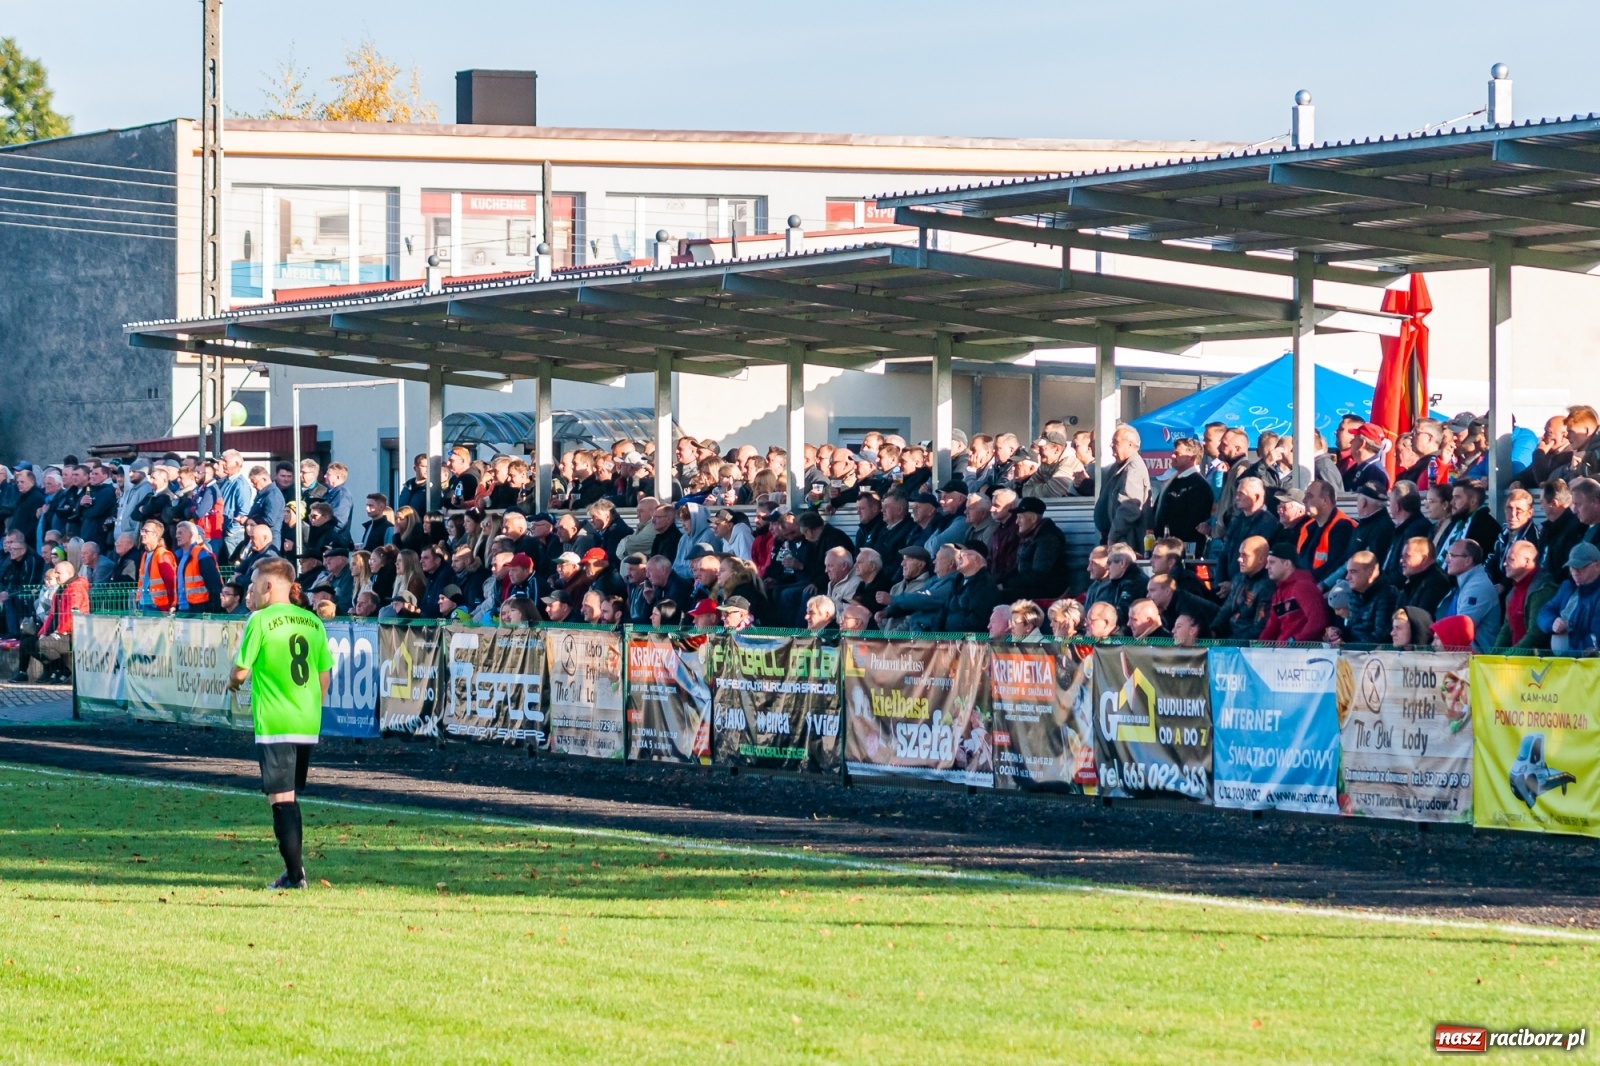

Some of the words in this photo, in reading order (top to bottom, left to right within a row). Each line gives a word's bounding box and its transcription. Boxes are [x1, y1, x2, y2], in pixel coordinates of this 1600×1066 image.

[470, 197, 527, 211] KUCHENNE
[281, 267, 321, 279] MEBLE
[325, 267, 341, 280] NA
[76, 650, 121, 675] PIŁKARSA
[289, 632, 309, 687] 8
[991, 659, 1053, 684] KREWETKA
[1215, 673, 1247, 692] SZYBKI
[1277, 668, 1326, 682] MARTCOM
[1402, 666, 1436, 689] Kebab
[1157, 698, 1206, 717] BUDUJEMY
[1402, 695, 1436, 724] Frytki
[725, 708, 746, 730] JAKO
[1220, 708, 1283, 732] INTERNET
[1494, 709, 1524, 727] POMOC
[1527, 711, 1572, 729] DROGOWA
[1573, 713, 1588, 730] 24h
[896, 709, 954, 761] szefa
[1159, 727, 1172, 744] OD
[1174, 729, 1182, 745] A
[1184, 730, 1198, 746] DO
[1200, 729, 1207, 746] Z
[1354, 719, 1371, 749] The
[1402, 728, 1428, 755] Lody
[1100, 759, 1123, 788] tel.
[1123, 763, 1145, 790] 665
[1148, 763, 1180, 790] 092
[1411, 769, 1424, 785] tel.
[1425, 772, 1434, 786] 32
[1453, 798, 1458, 810] 2
